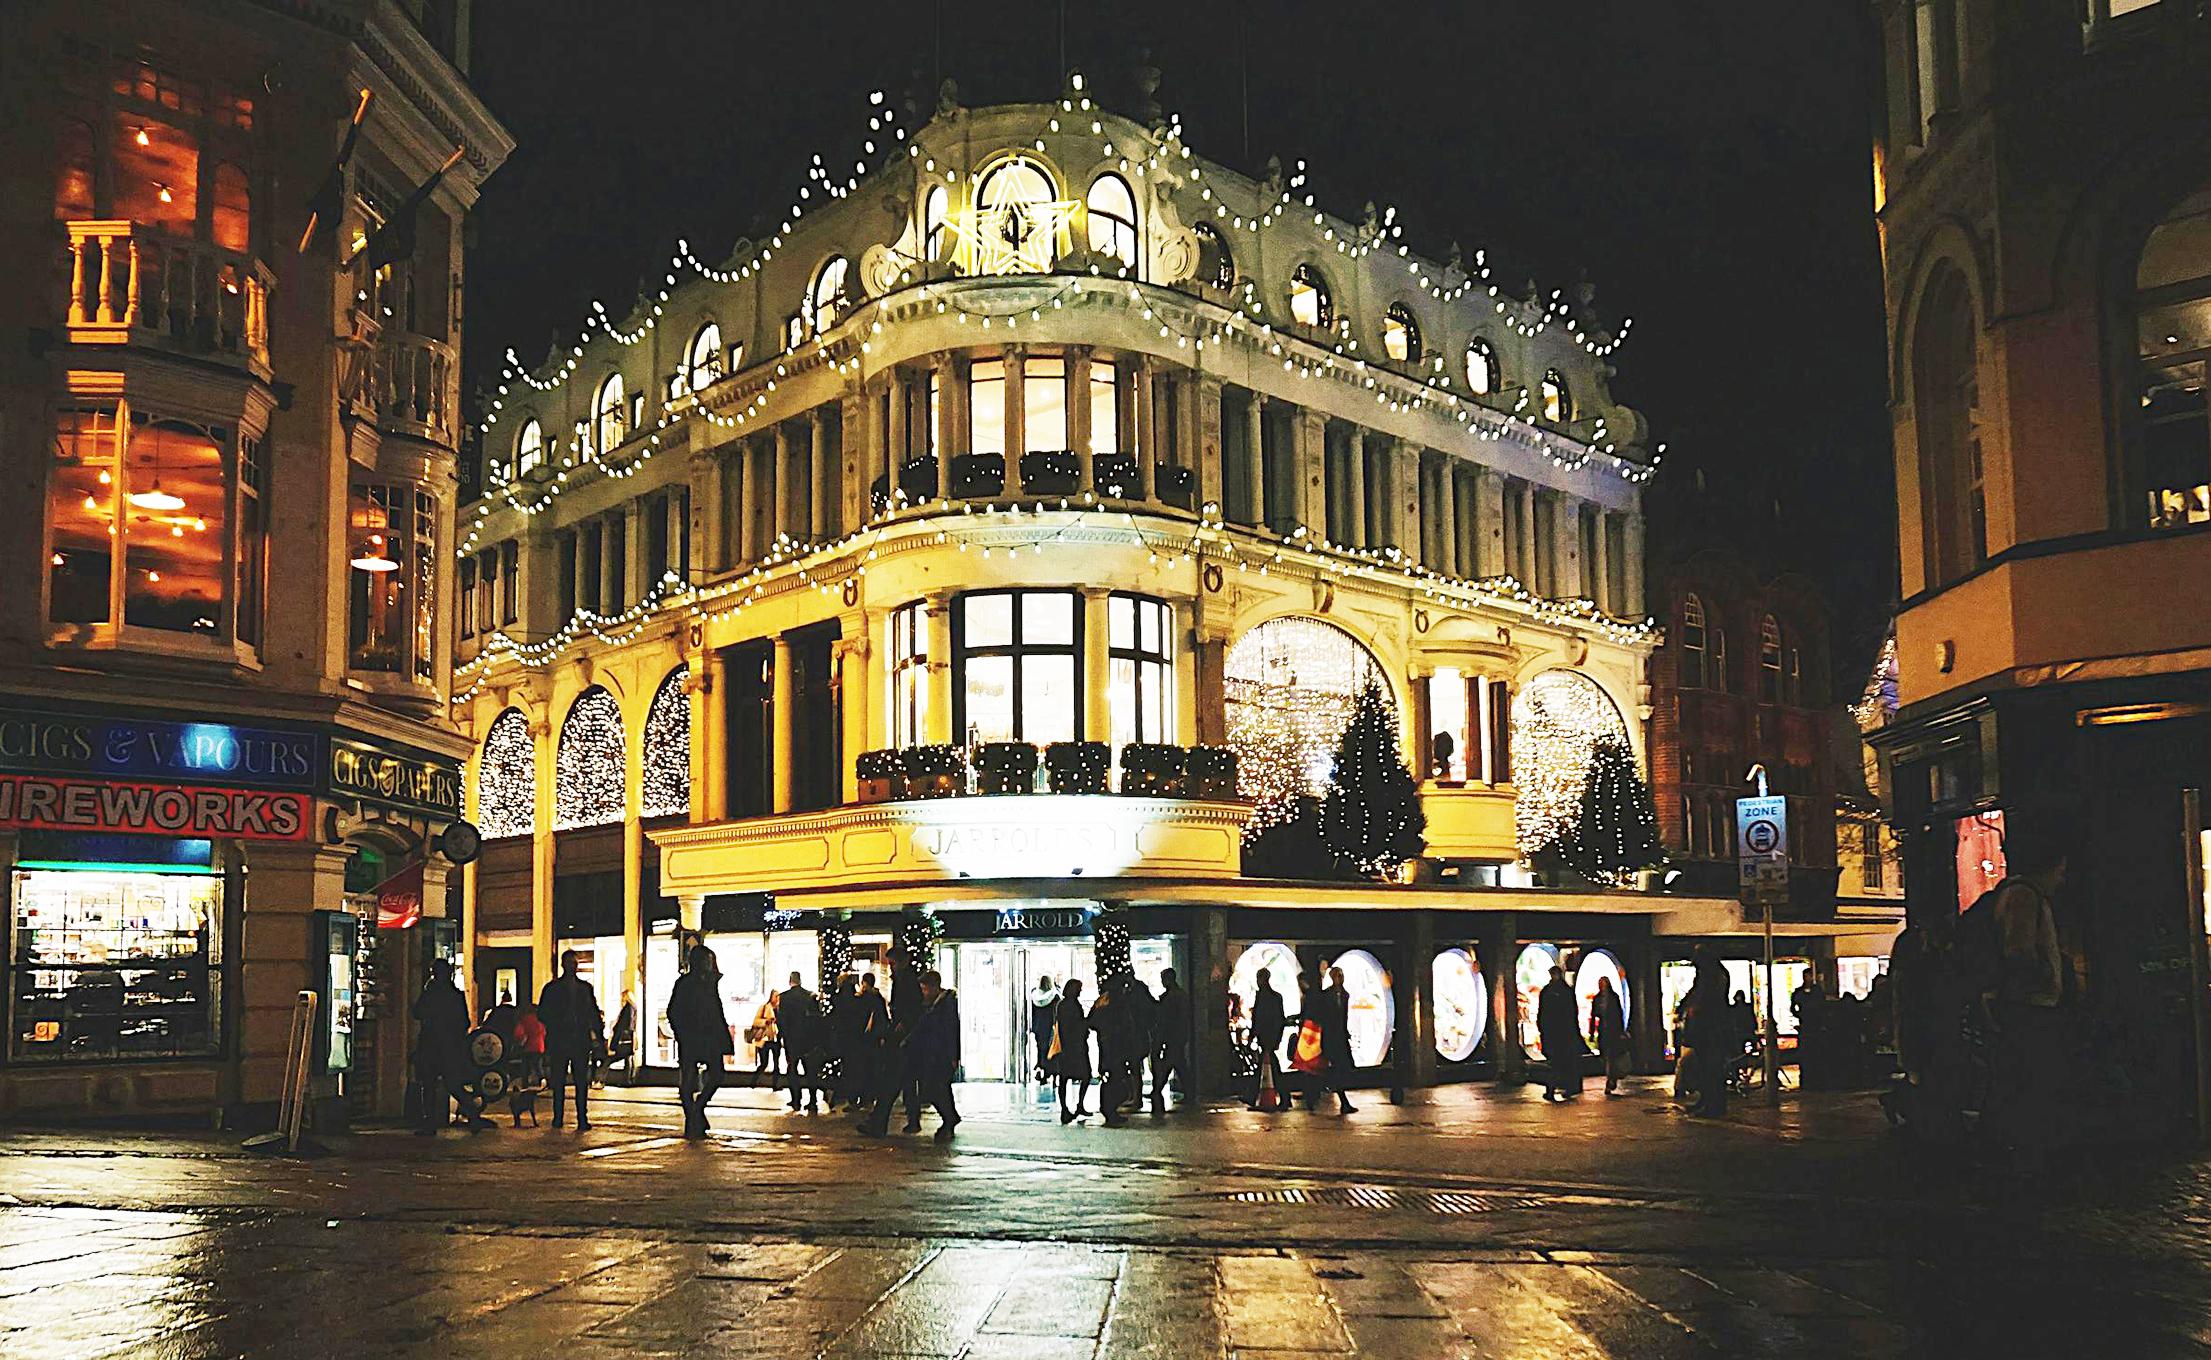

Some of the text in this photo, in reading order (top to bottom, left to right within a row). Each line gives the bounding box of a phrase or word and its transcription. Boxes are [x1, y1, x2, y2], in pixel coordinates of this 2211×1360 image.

[0, 720, 309, 776] CIGS & VAPOURS
[334, 748, 378, 791] CIGS
[395, 762, 456, 807] PAPERS
[1745, 806, 1777, 817] ZONE
[992, 912, 1084, 934] JARROLD
